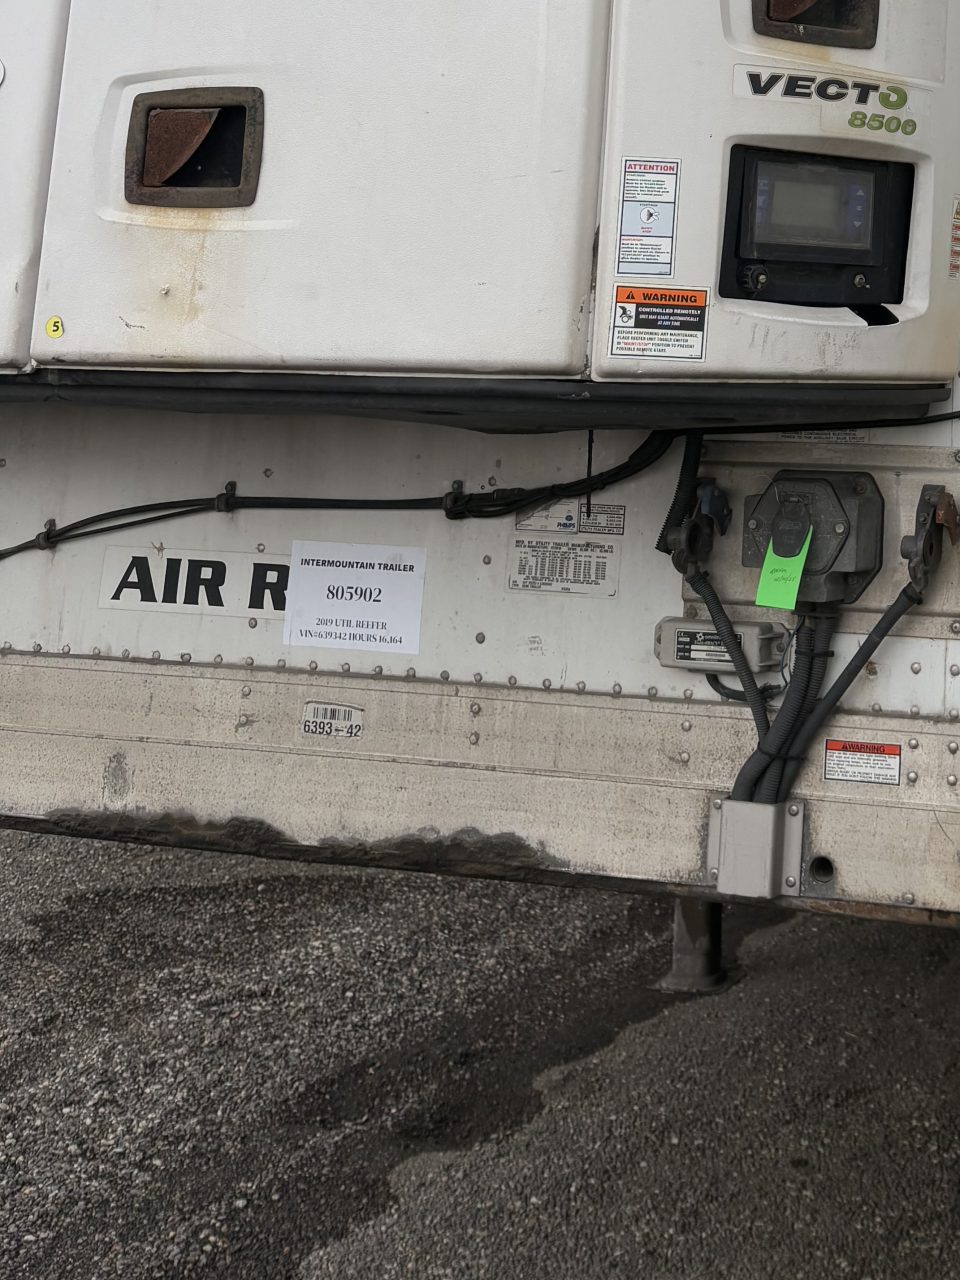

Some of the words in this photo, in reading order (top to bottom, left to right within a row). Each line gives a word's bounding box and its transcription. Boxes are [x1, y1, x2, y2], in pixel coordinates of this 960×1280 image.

[848, 111, 917, 135] 8500
[627, 163, 675, 171] ATTENTION
[642, 293, 697, 303] WARNING
[52, 321, 60, 332] 5
[301, 558, 375, 570] INTERMOUNTAIN
[377, 563, 414, 572] TRAILER
[111, 555, 227, 607] AIR
[327, 584, 382, 602] 805902
[316, 618, 334, 626] 2019
[356, 620, 387, 630] REEFER
[349, 632, 377, 642] HOURS
[848, 744, 885, 753] WARNING
